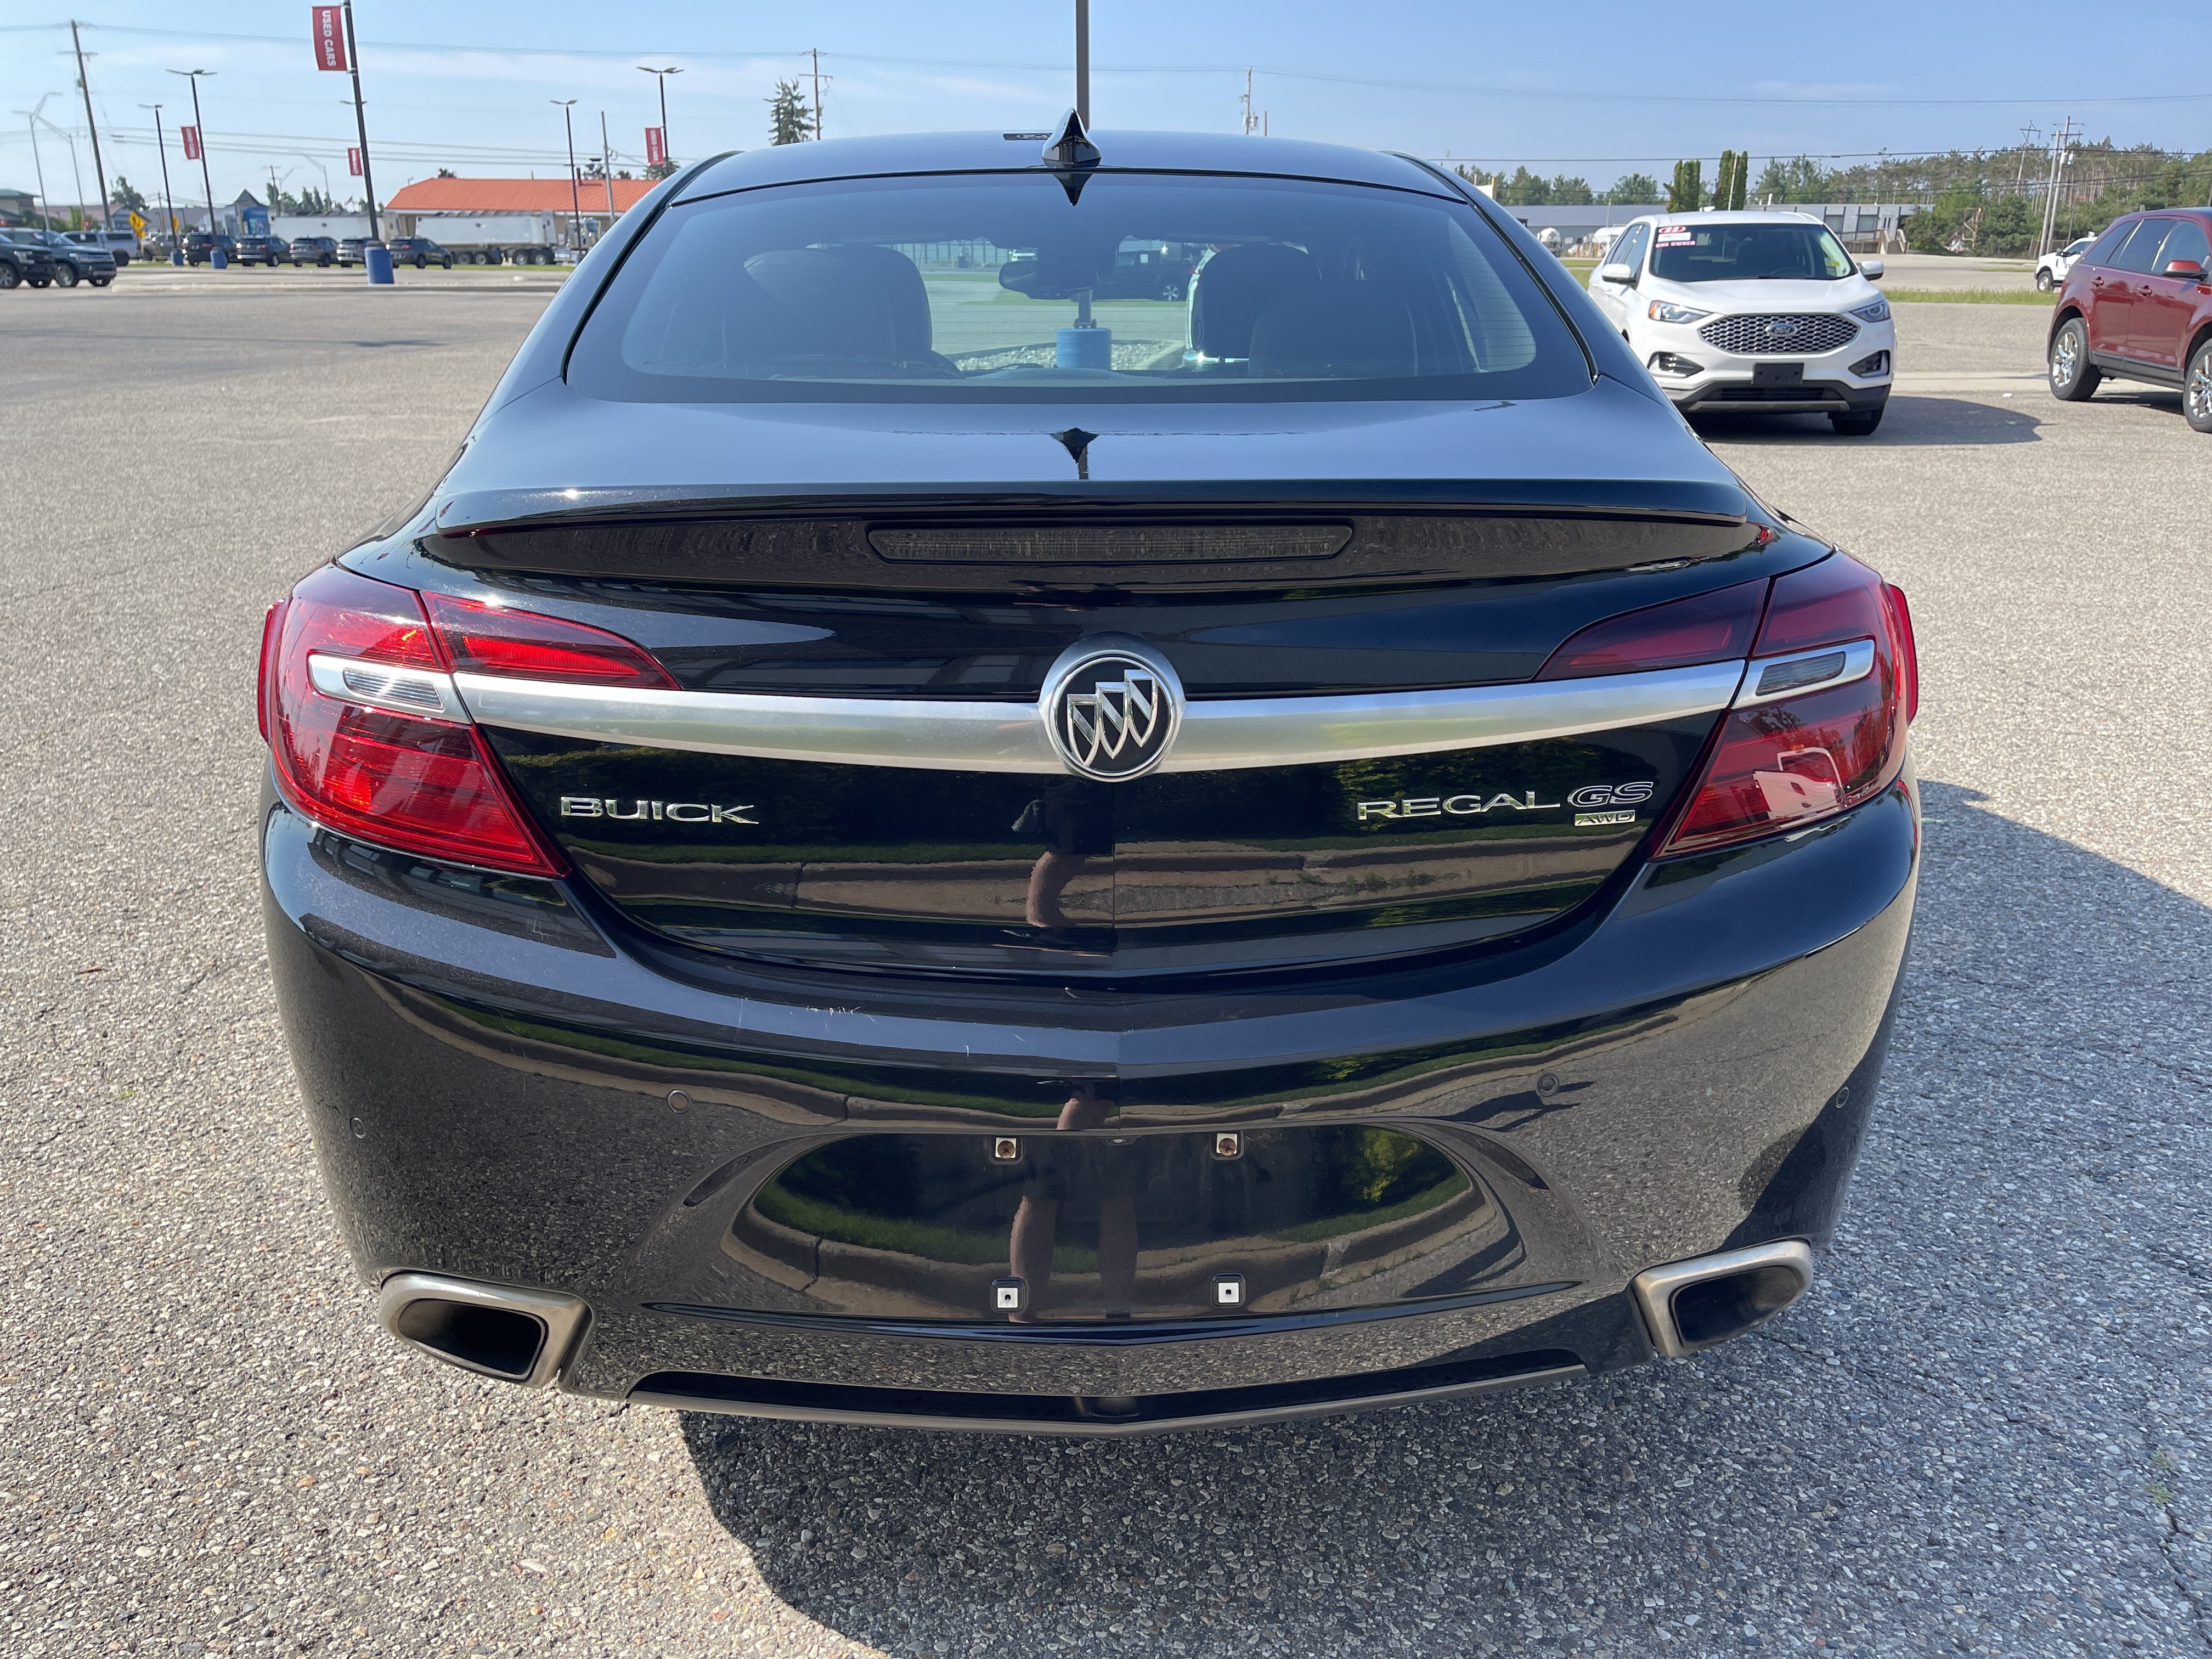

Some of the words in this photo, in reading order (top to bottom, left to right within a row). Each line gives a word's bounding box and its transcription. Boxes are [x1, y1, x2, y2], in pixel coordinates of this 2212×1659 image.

[321, 10, 332, 37] USED
[324, 39, 336, 66] CARS
[560, 797, 759, 824] BUICK
[1357, 790, 1561, 821] REGAL
[1568, 781, 1654, 808] GS
[1577, 812, 1633, 825] AWD
